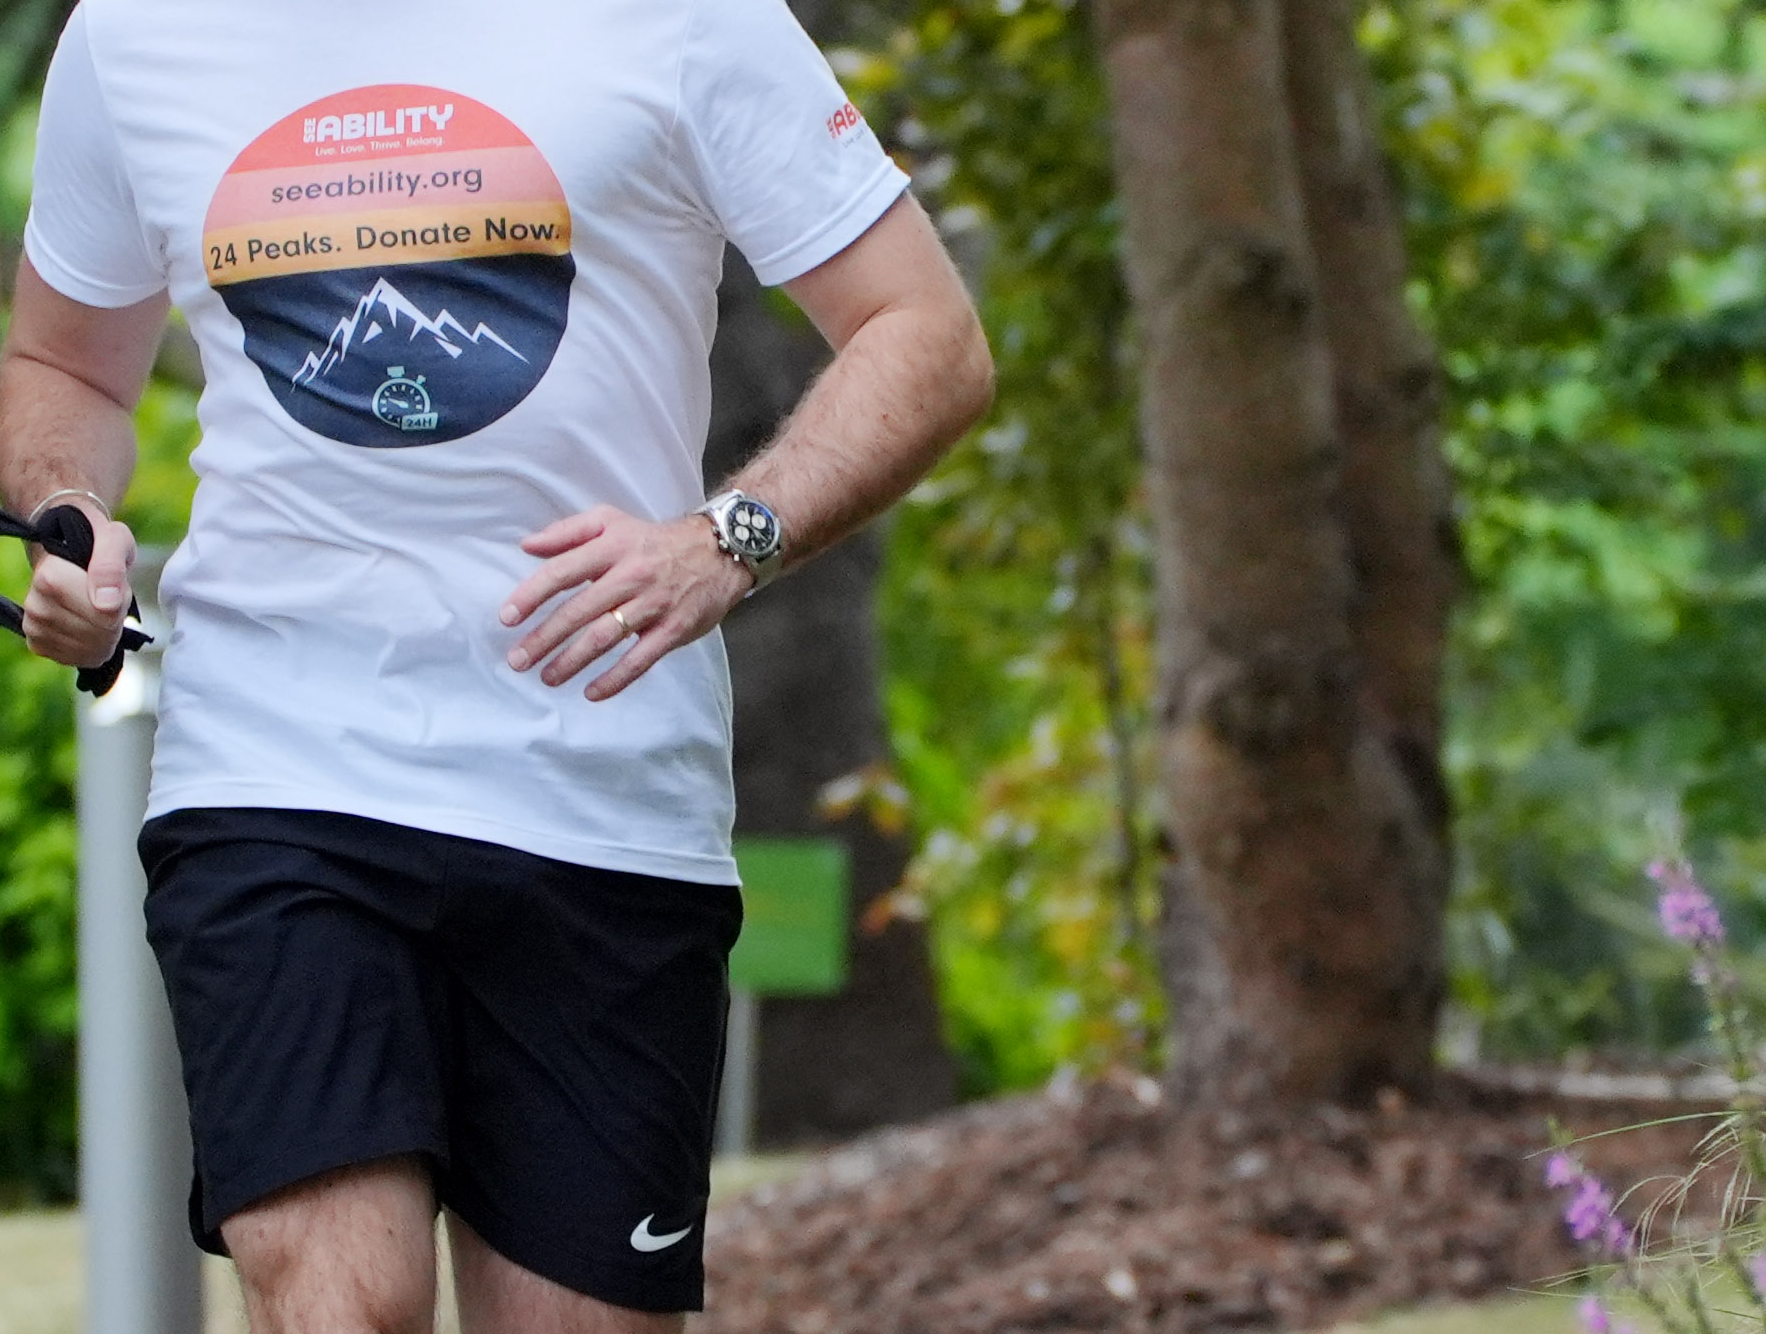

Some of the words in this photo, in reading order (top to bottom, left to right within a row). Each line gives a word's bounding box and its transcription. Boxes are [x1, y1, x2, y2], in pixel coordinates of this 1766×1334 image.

[317, 103, 454, 142] ABILITY
[406, 136, 445, 148] Belong.
[271, 168, 483, 204] seeability.org
[210, 242, 238, 270] 24
[247, 231, 342, 263] Peaks.
[356, 222, 471, 250] Donate
[484, 217, 560, 241] Now.
[406, 417, 432, 427] 24H
